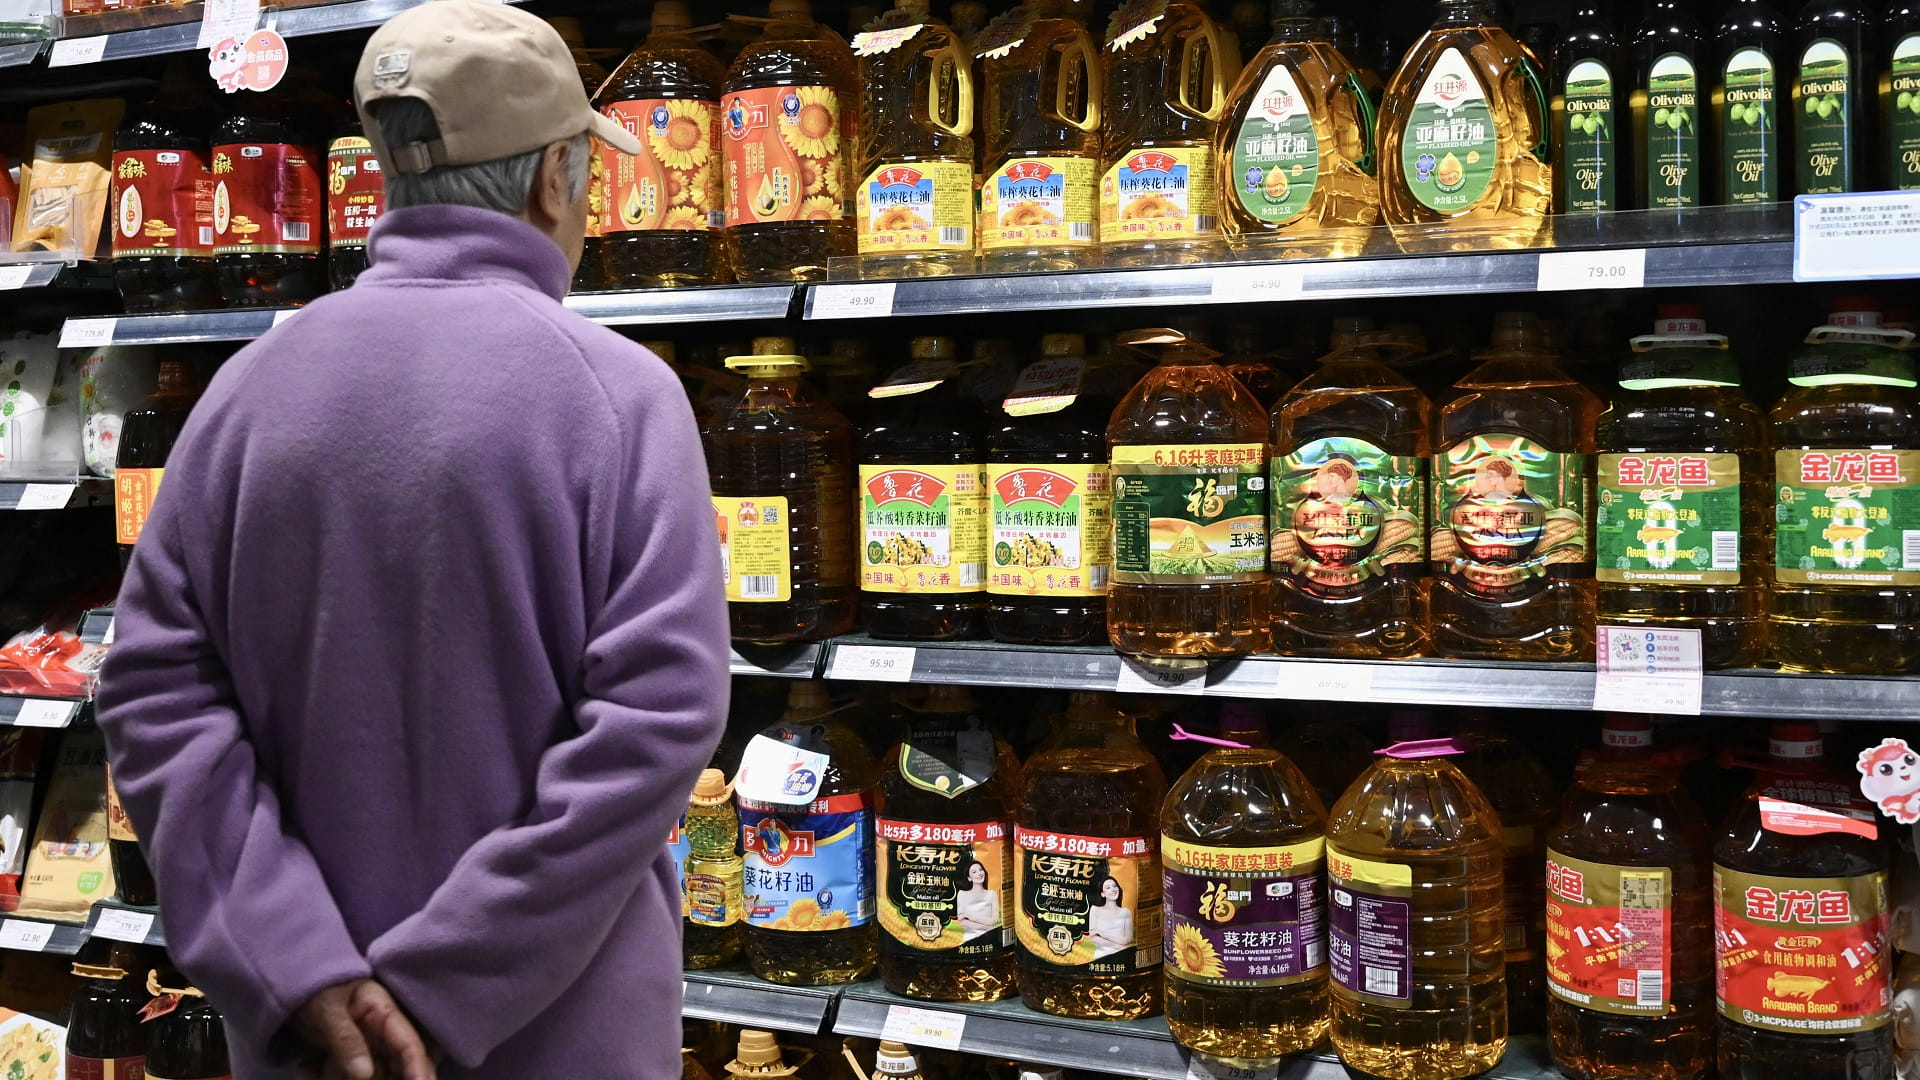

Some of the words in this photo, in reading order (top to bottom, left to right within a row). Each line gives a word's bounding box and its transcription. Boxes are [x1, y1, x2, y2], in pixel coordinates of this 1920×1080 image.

[1434, 80, 1467, 95] 红井源
[1802, 80, 1846, 95] Olivoilà
[1651, 94, 1694, 106] Olivoilà
[1727, 89, 1771, 101] Olivoilà
[1262, 97, 1293, 109] 红井源
[1567, 99, 1609, 112] Olivoilà
[1416, 123, 1485, 145] 亚麻籽油
[1245, 137, 1308, 156] 亚麻籽油
[1736, 160, 1764, 172] Olive
[1810, 154, 1838, 167] Olive
[1576, 169, 1602, 181] Olive
[1660, 165, 1687, 177] Olive
[1742, 169, 1759, 182] Oil
[1815, 165, 1832, 177] Oil
[1120, 176, 1185, 191] 压榨葵花仁油
[1582, 179, 1597, 190] Oil
[1666, 174, 1682, 186] Oil
[871, 190, 930, 205] 压榨葵花仁油
[999, 185, 1061, 200] 压榨葵花仁油
[1122, 223, 1146, 232] 中国味
[873, 236, 894, 244] 中国味
[1000, 230, 1023, 239] 中国味
[1588, 265, 1626, 278] 79.00
[849, 296, 875, 306] 49.90
[1618, 457, 1708, 485] 金龙鱼
[1801, 453, 1899, 482] 金龙鱼
[120, 477, 134, 536] 胡姬花
[867, 511, 947, 527] 低芥酸特香菜籽油
[995, 511, 1077, 527] 低芥酸特香菜籽油
[865, 572, 895, 584] 中国味
[992, 572, 1022, 586] 中国味
[869, 658, 895, 669] 95.90
[1158, 672, 1184, 682] 79.90
[883, 824, 976, 842] 比5升多180毫升
[1019, 833, 1112, 856] 比5升多180毫升
[1122, 838, 1146, 854] 加量
[760, 849, 785, 863] MIGHTY
[896, 845, 961, 865] 长寿花
[1175, 847, 1294, 871] 6.16升家庭实惠装
[931, 864, 956, 872] FLOWER
[1031, 854, 1095, 878] 长寿花
[744, 867, 814, 893] 葵花籽油
[907, 872, 950, 887] 金胚玉米油
[1034, 872, 1064, 882] LONGEVITY
[1065, 875, 1090, 886] FLOWER
[1041, 882, 1083, 901] 金胚玉米油
[915, 901, 942, 910] 非转基因
[1745, 886, 1851, 924] 金龙鱼
[921, 918, 935, 926] 压榨
[1047, 913, 1075, 924] 非转基因
[1052, 931, 1067, 940] 压榨
[1223, 929, 1293, 947] 葵花籽油
[1573, 922, 1635, 947] 1:1:1
[958, 943, 994, 954] 净含量:5.18升
[1778, 936, 1821, 948] 黄金比例
[1763, 951, 1837, 968] 食用植物调和油
[1088, 963, 1126, 973] 净含量:5.18升
[1248, 963, 1290, 975] 净含量:6.16升
[1228, 1068, 1256, 1079] 79.90
